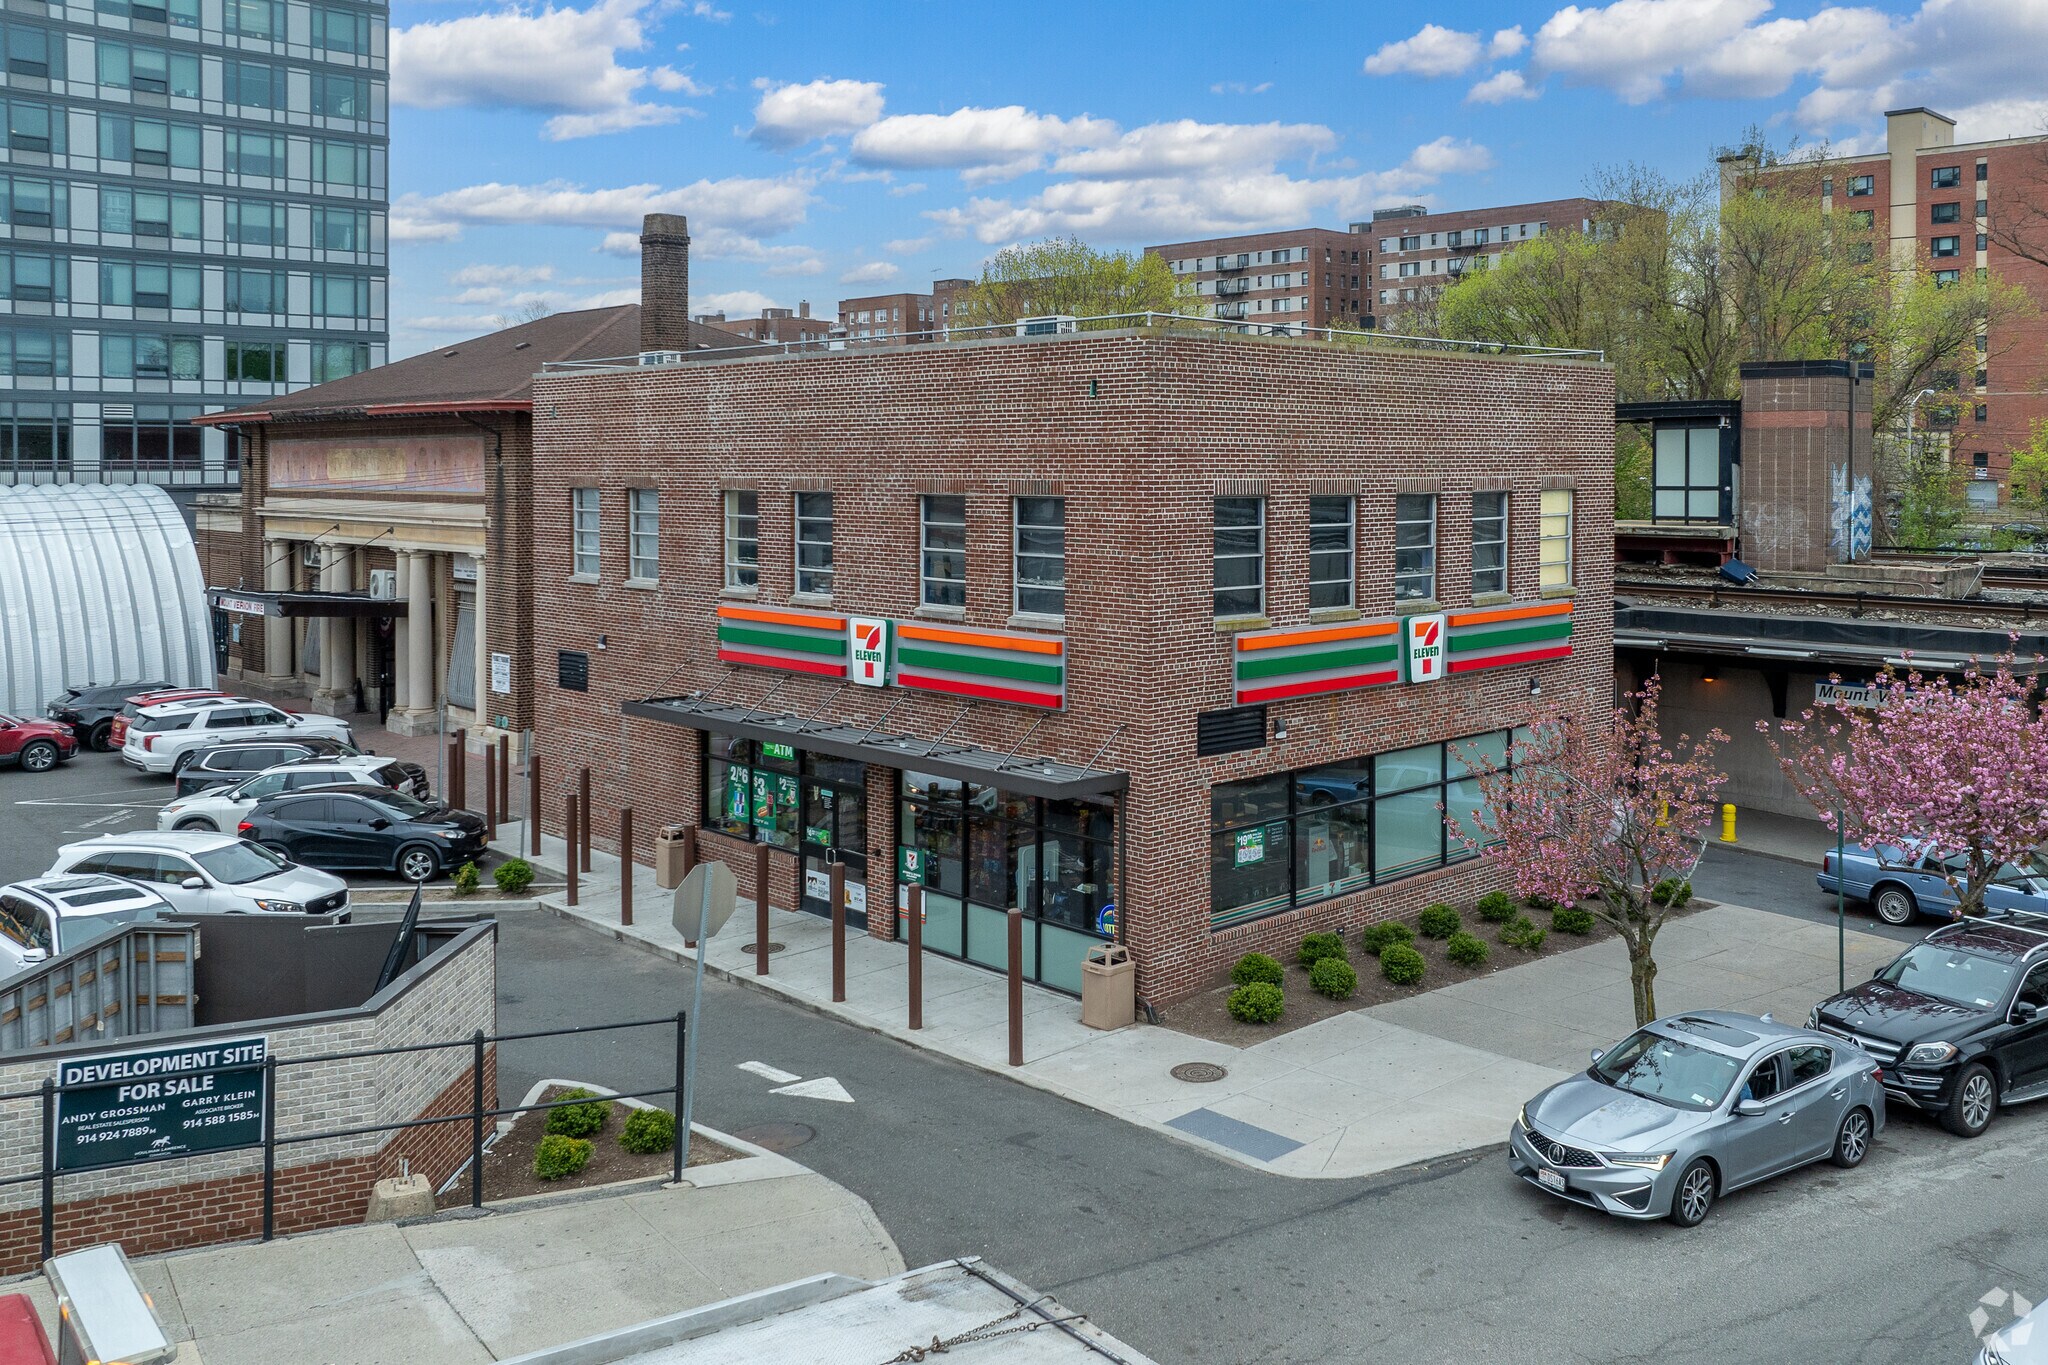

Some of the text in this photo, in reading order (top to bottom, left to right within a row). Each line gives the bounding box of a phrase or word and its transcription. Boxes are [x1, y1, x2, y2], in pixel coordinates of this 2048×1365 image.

[234, 600, 252, 610] VERNON
[254, 603, 263, 612] FIRE
[856, 624, 880, 650] 7
[1415, 621, 1439, 646] 7
[1819, 685, 1870, 701] Mount
[773, 744, 793, 758] ATM
[730, 765, 749, 784] 2/$6
[753, 776, 765, 796] $3
[779, 777, 787, 791] $2
[66, 1044, 264, 1085] DEVELOPMENT SITE
[119, 1075, 214, 1102] FOR SALE
[182, 1090, 256, 1108] GARRY KLEIN
[61, 1103, 166, 1125] ANDY GROSSMAN
[194, 1103, 244, 1115] ASSOCIATE BROKER
[77, 1116, 150, 1131] REAL ESTATE SALESPERSON
[182, 1118, 203, 1130] 914
[205, 1115, 226, 1127] 588
[77, 1132, 97, 1145] 914
[99, 1129, 120, 1142] 924
